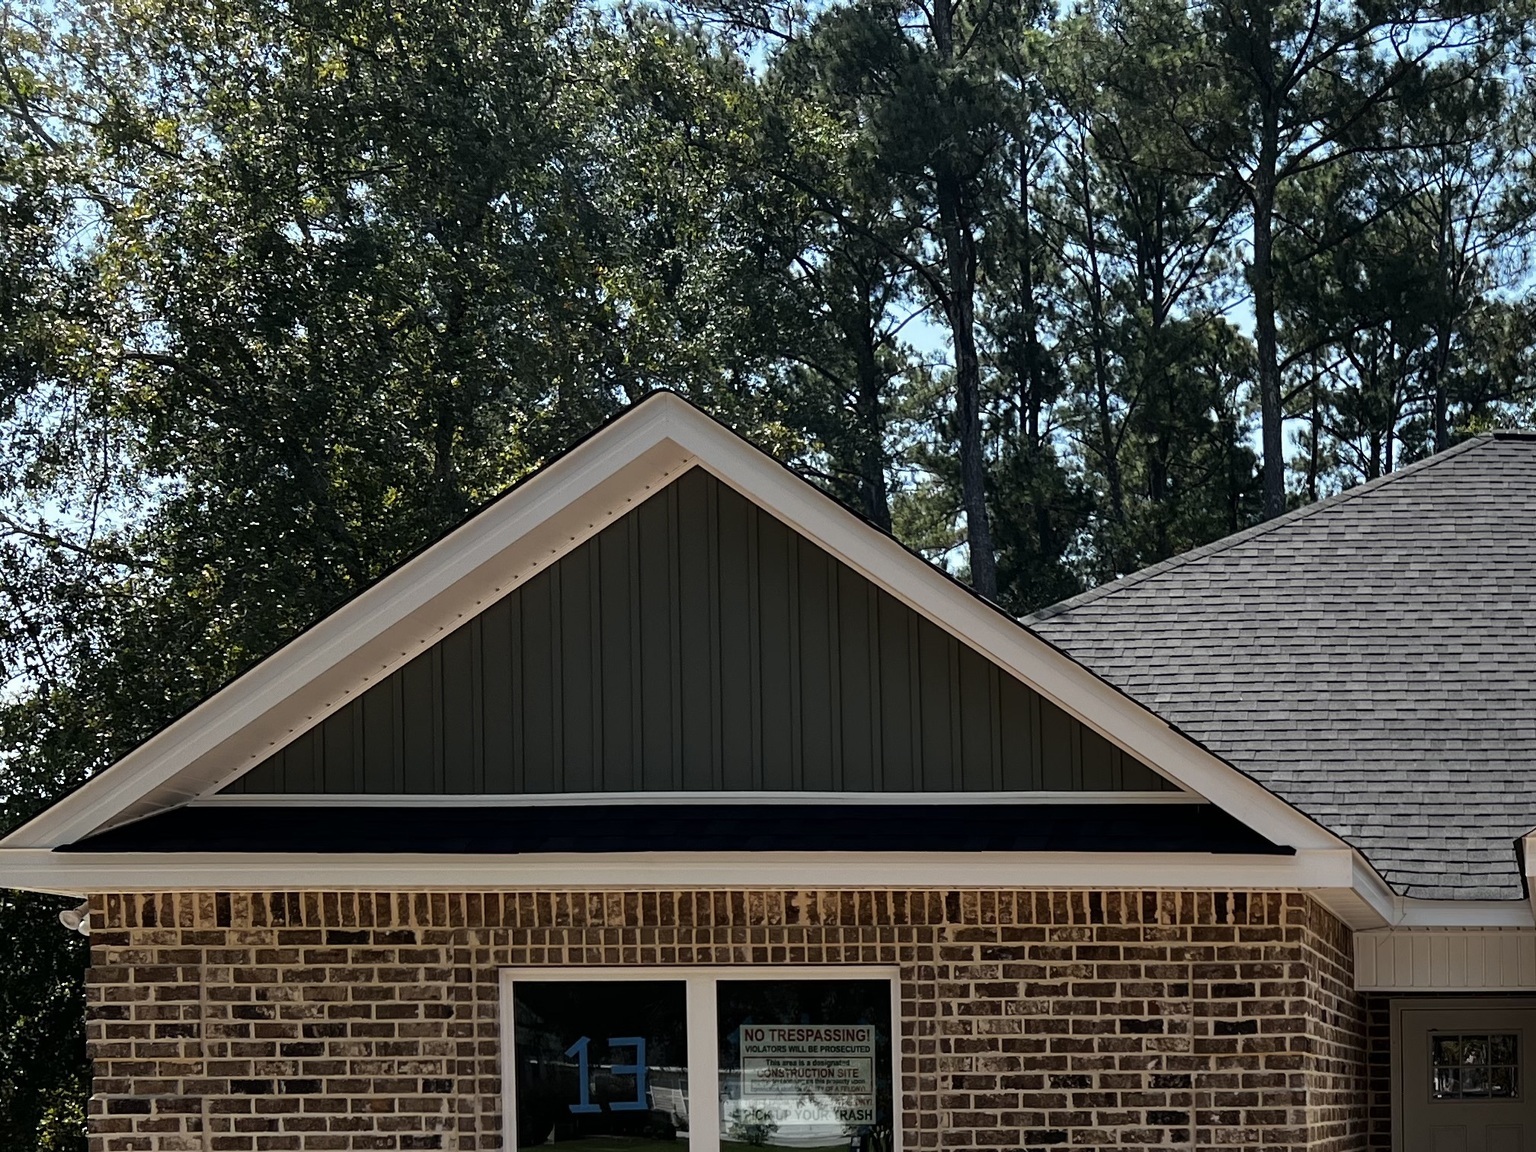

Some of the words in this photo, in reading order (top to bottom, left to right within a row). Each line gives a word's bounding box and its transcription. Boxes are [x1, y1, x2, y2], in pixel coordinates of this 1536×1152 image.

[744, 1029, 765, 1042] NO
[768, 1029, 870, 1042] TRESPASSING!
[745, 1045, 787, 1053] VIOLATORS
[788, 1045, 806, 1053] WILL
[808, 1045, 818, 1053] BE
[820, 1045, 871, 1053] PROSECUTED
[766, 1059, 781, 1067] This
[798, 1059, 805, 1067] is
[812, 1059, 850, 1068] designated
[564, 1036, 648, 1113] 13
[757, 1068, 834, 1078] CONSTRUCTION
[837, 1068, 859, 1078] SITE
[776, 1109, 792, 1121] UP
[795, 1109, 828, 1121] YOUR
